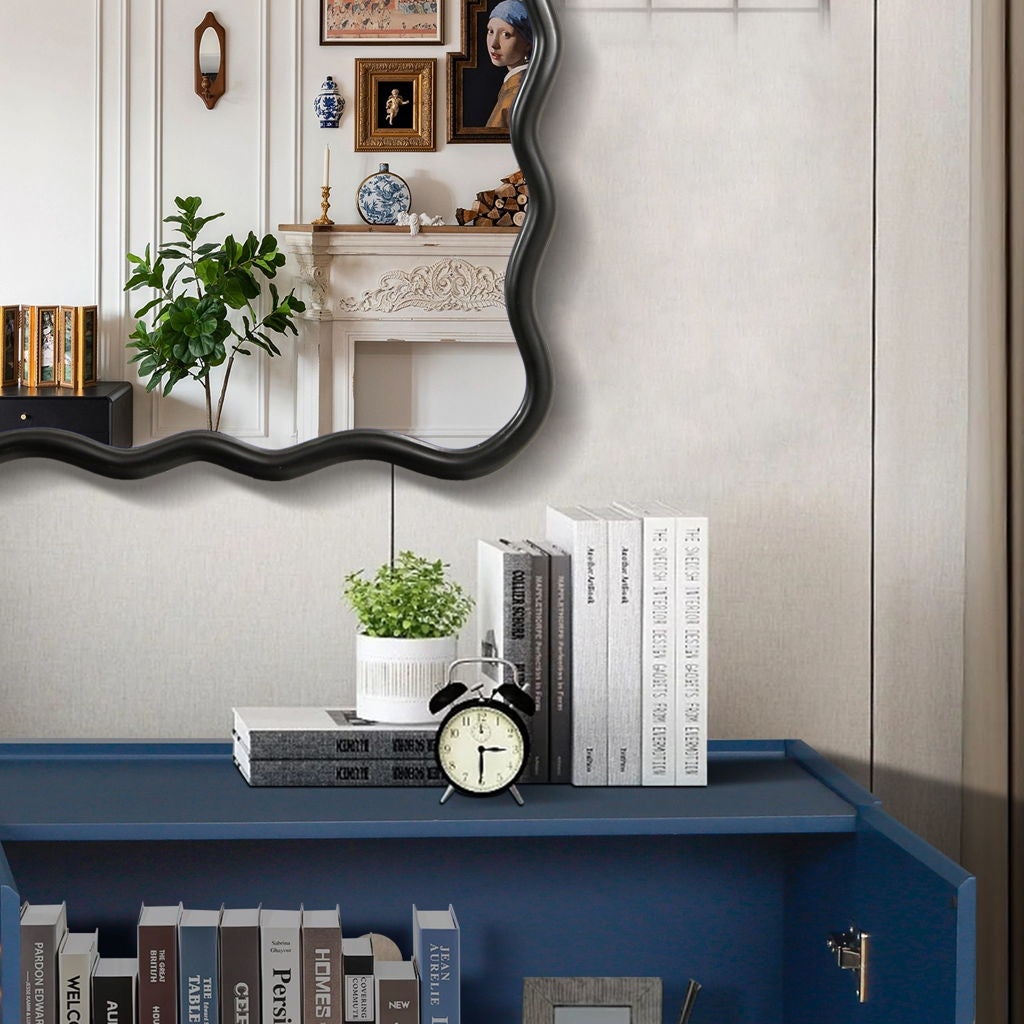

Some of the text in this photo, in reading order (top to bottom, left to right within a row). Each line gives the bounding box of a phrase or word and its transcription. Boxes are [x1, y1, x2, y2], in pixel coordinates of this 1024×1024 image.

[652, 528, 668, 542] THE
[685, 528, 700, 542] THE
[34, 942, 44, 985] PARDON
[430, 944, 440, 1006] AURELIE
[440, 945, 450, 981] JEAN
[188, 975, 201, 1022] TABLE
[203, 978, 212, 999] THE
[315, 949, 331, 1017] HOMES
[389, 1001, 410, 1009] NEW
